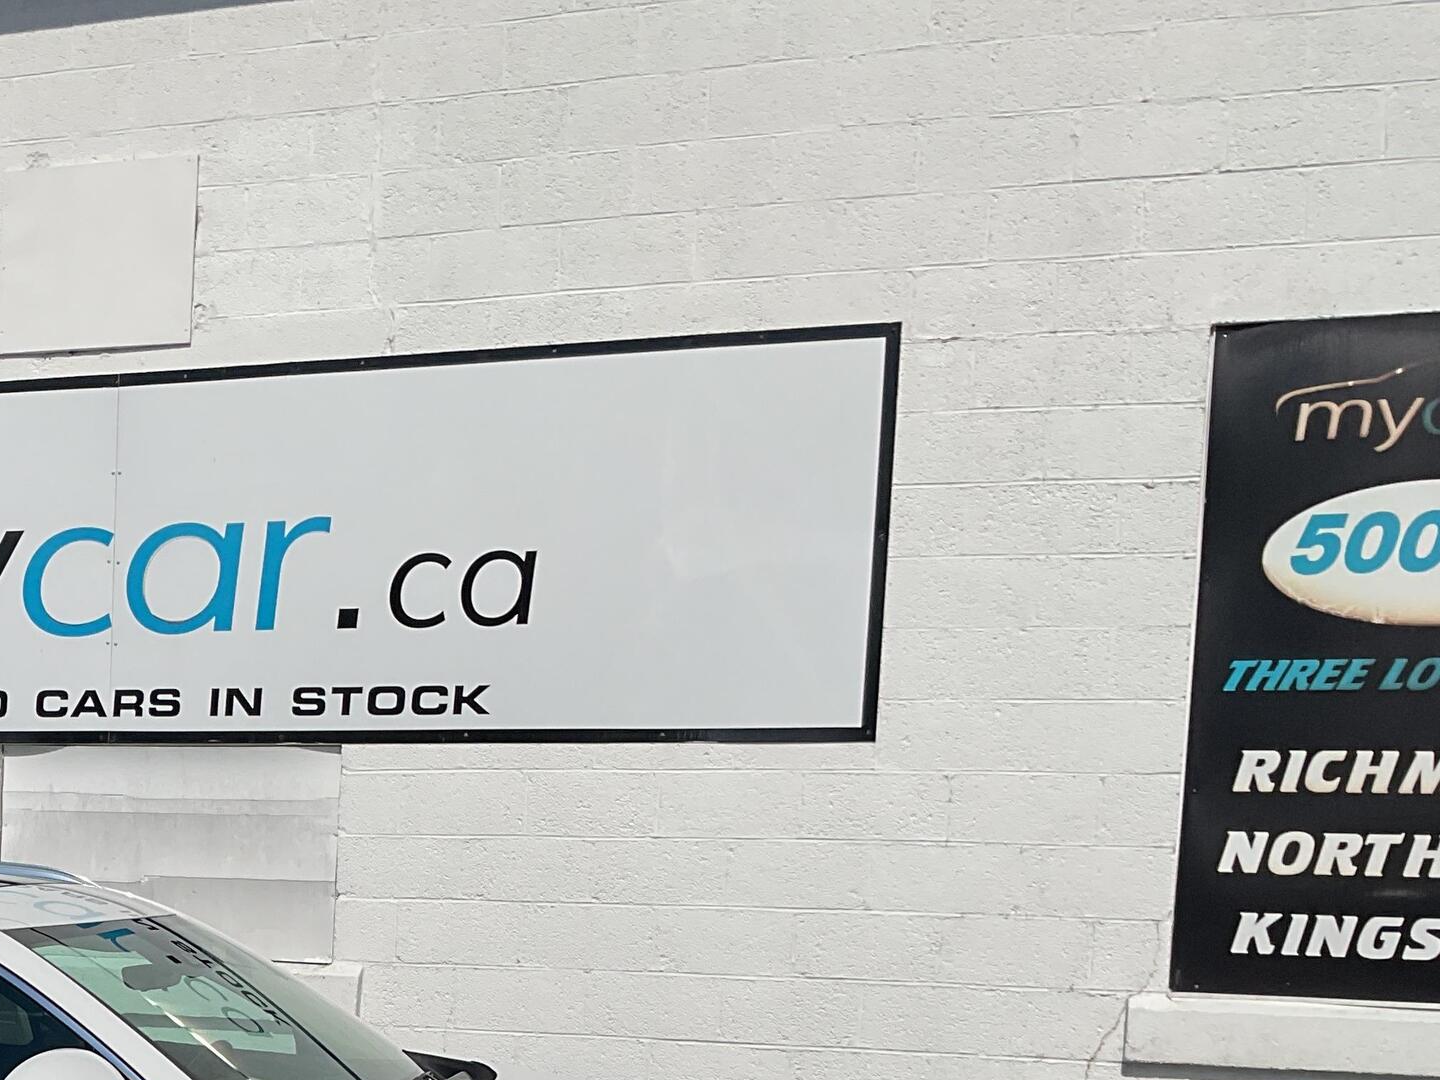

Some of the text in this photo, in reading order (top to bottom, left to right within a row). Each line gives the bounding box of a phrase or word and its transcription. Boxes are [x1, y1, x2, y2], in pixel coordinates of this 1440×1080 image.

[1222, 657, 1375, 693] THREE
[35, 688, 181, 718] CARS
[209, 687, 263, 717] IN
[291, 684, 490, 717] STOCK
